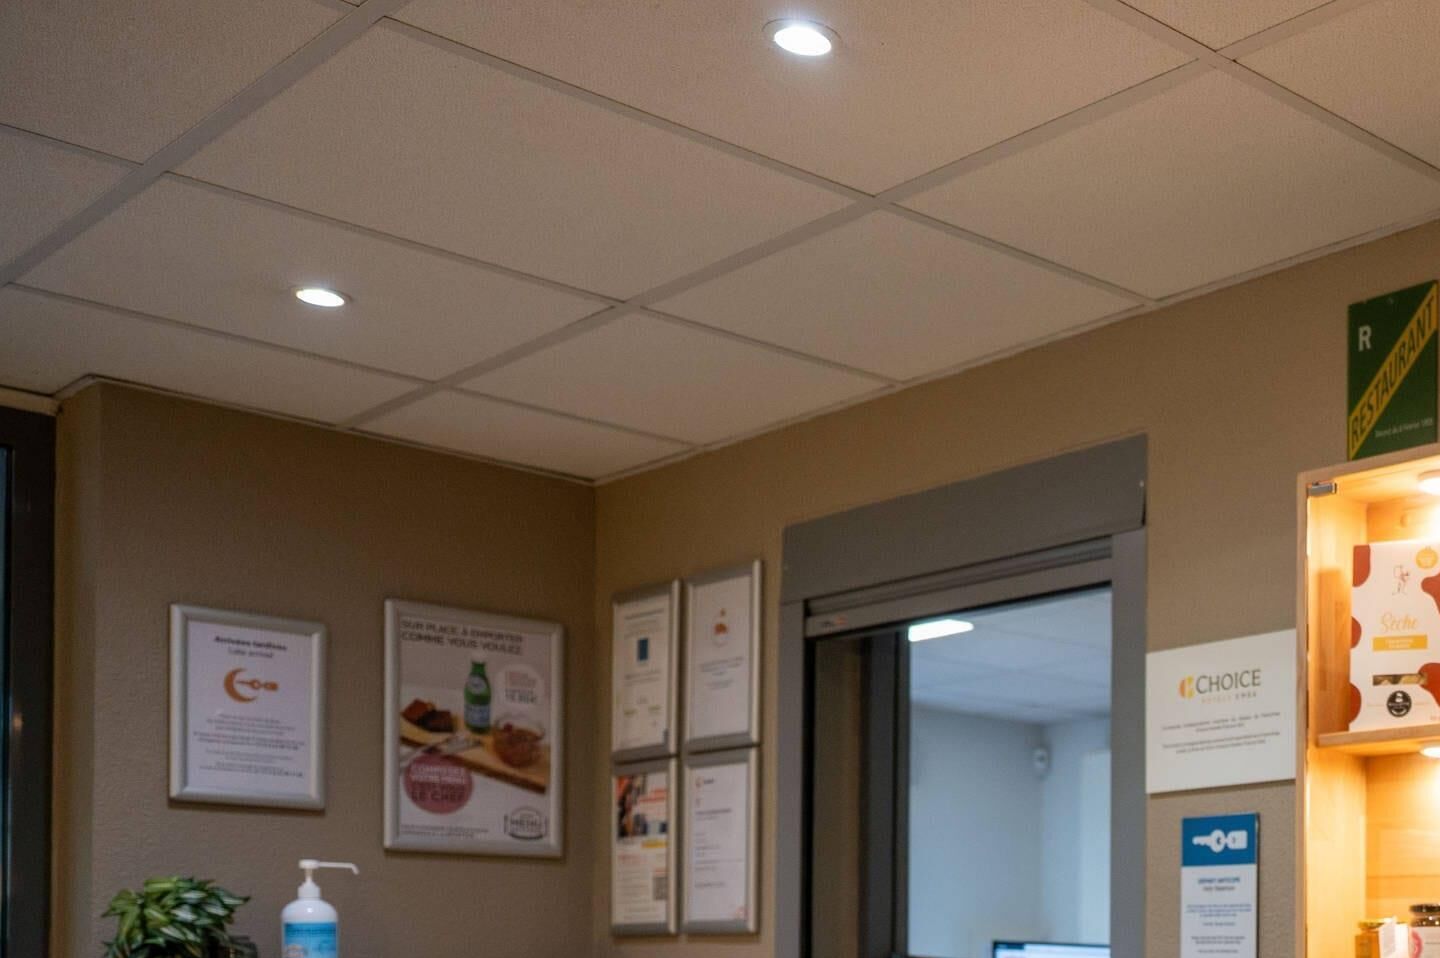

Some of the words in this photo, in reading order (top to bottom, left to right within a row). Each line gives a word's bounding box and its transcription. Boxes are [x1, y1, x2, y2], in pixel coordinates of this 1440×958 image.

[1358, 325, 1373, 352] R
[1351, 296, 1434, 450] RESTAURANT
[400, 631, 444, 644] COMME
[448, 637, 478, 649] VOUS
[1196, 669, 1261, 694] CHOICE
